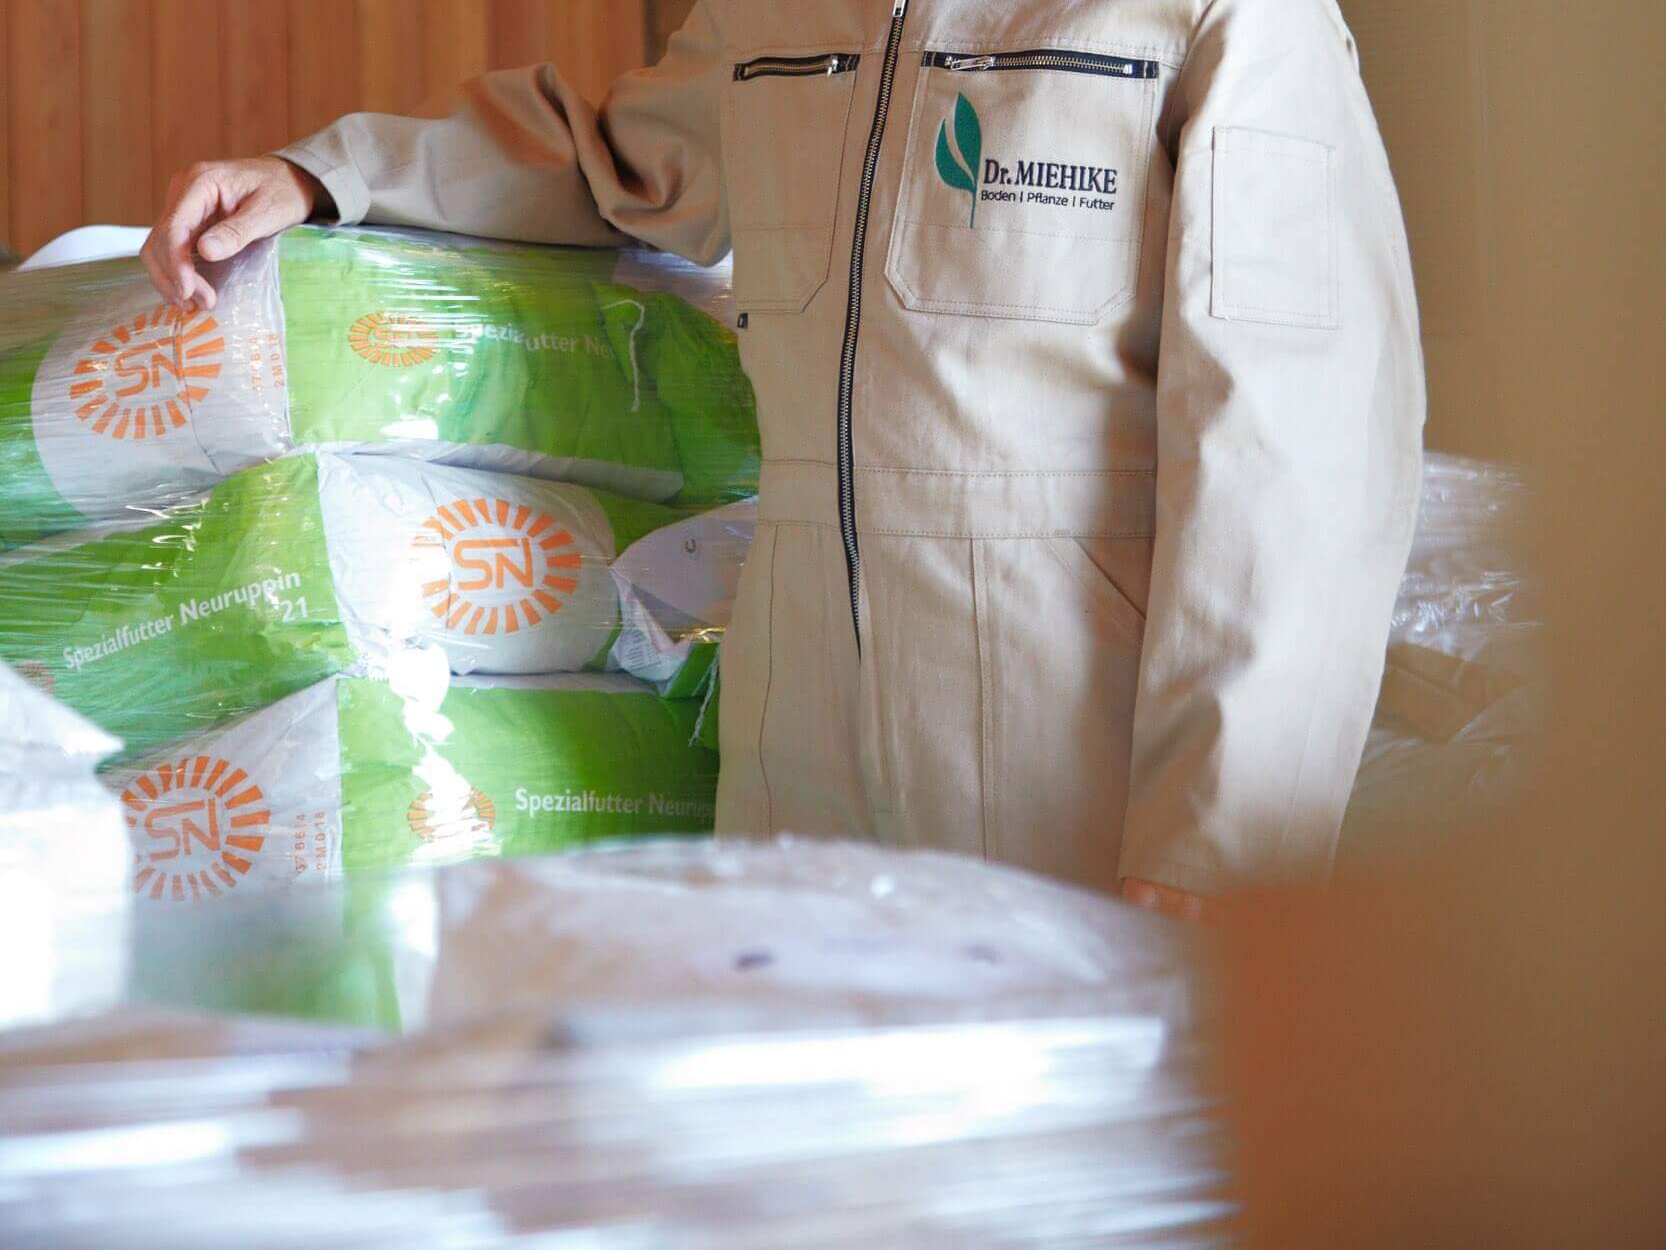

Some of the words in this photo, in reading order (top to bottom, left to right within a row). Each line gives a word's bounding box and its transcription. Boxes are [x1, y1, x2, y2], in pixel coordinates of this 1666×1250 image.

[981, 189, 1016, 203] Boden
[1027, 192, 1069, 207] Pflanze
[1080, 197, 1115, 211] Futter
[114, 334, 184, 397] SN
[453, 536, 534, 591] SN
[62, 611, 174, 671] Spezialfutter
[178, 566, 301, 626] Neuruppin
[281, 595, 308, 623] 21
[144, 797, 221, 862] SN
[515, 787, 641, 818] Spezialfutter
